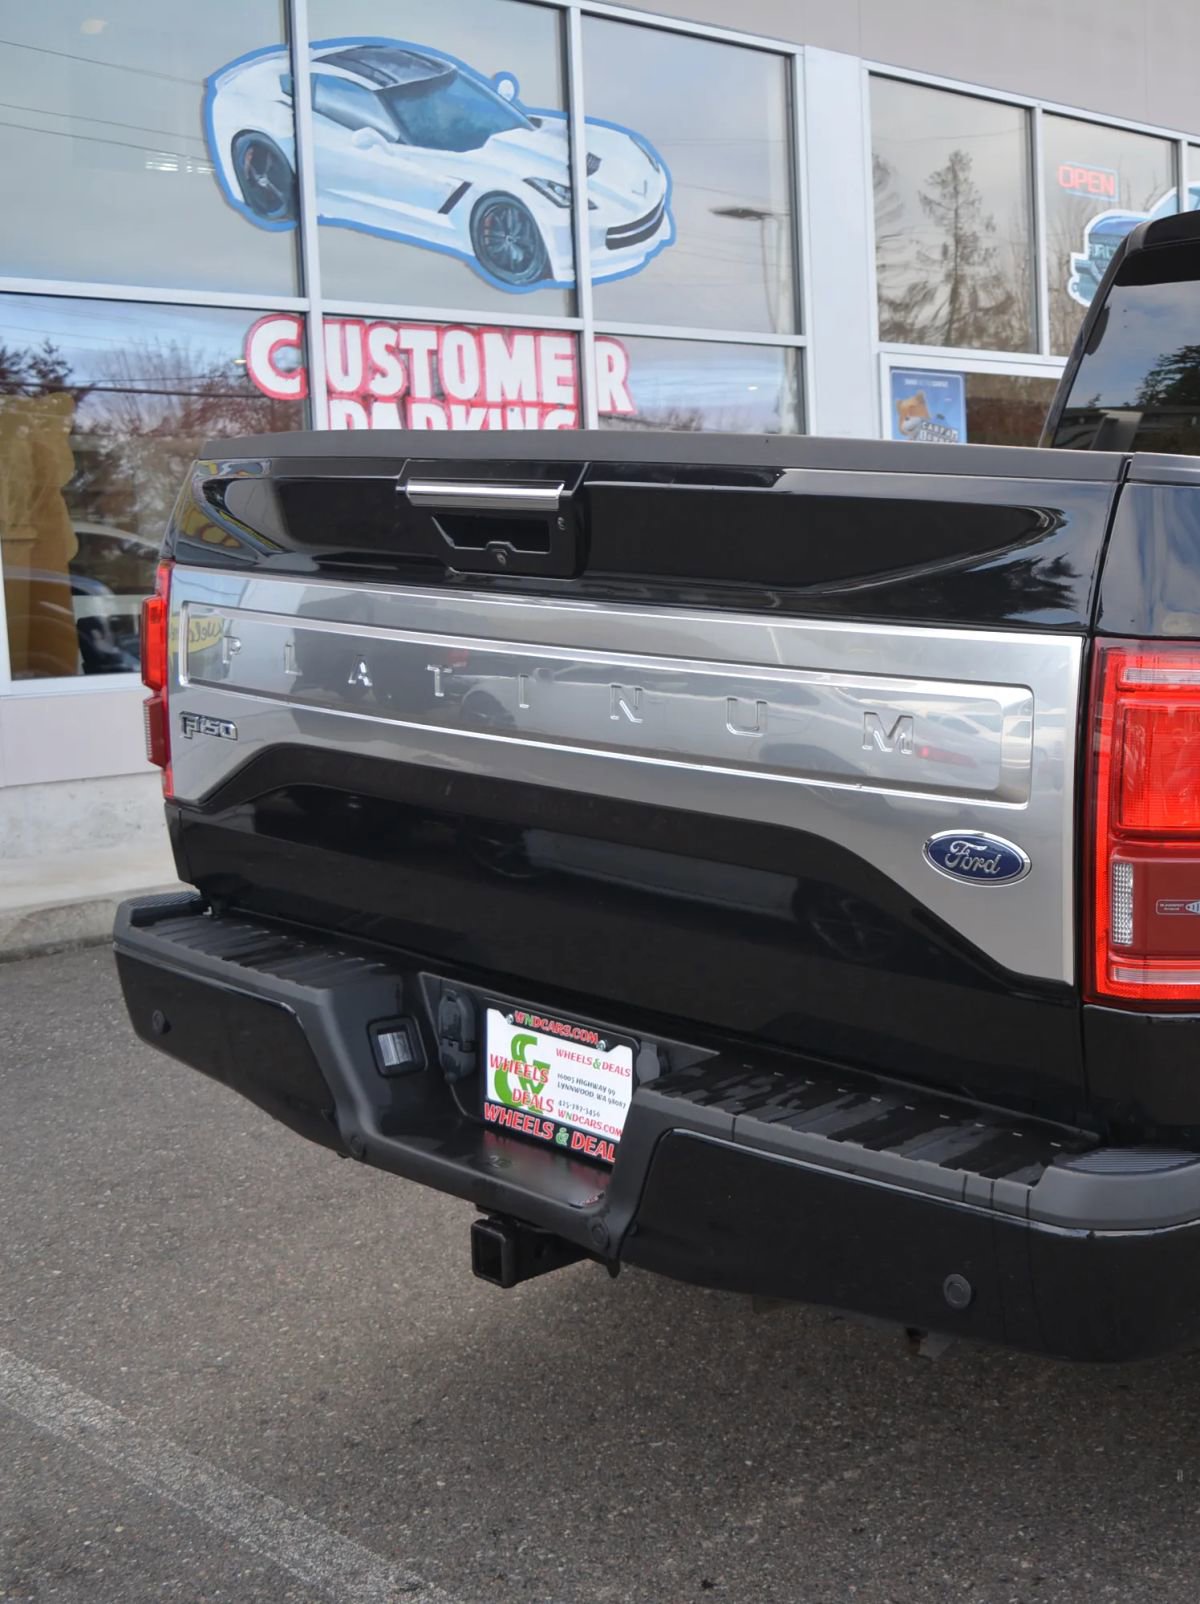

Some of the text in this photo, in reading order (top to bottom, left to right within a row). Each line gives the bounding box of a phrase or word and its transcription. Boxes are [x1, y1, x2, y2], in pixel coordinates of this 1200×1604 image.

[1058, 165, 1115, 196] OPEN
[246, 314, 637, 415] CUSTOMER
[223, 634, 915, 756] PLATINUM
[944, 840, 1002, 874] Ford
[514, 1010, 599, 1045] WNDCARS.COM
[490, 1053, 549, 1084] WHEELS
[512, 1088, 555, 1113] DEALS
[575, 1077, 607, 1093] HIGHWAY
[608, 1088, 616, 1096] 99
[596, 1093, 607, 1102] WA
[483, 1102, 555, 1140] WHEELS
[555, 1127, 570, 1147] &
